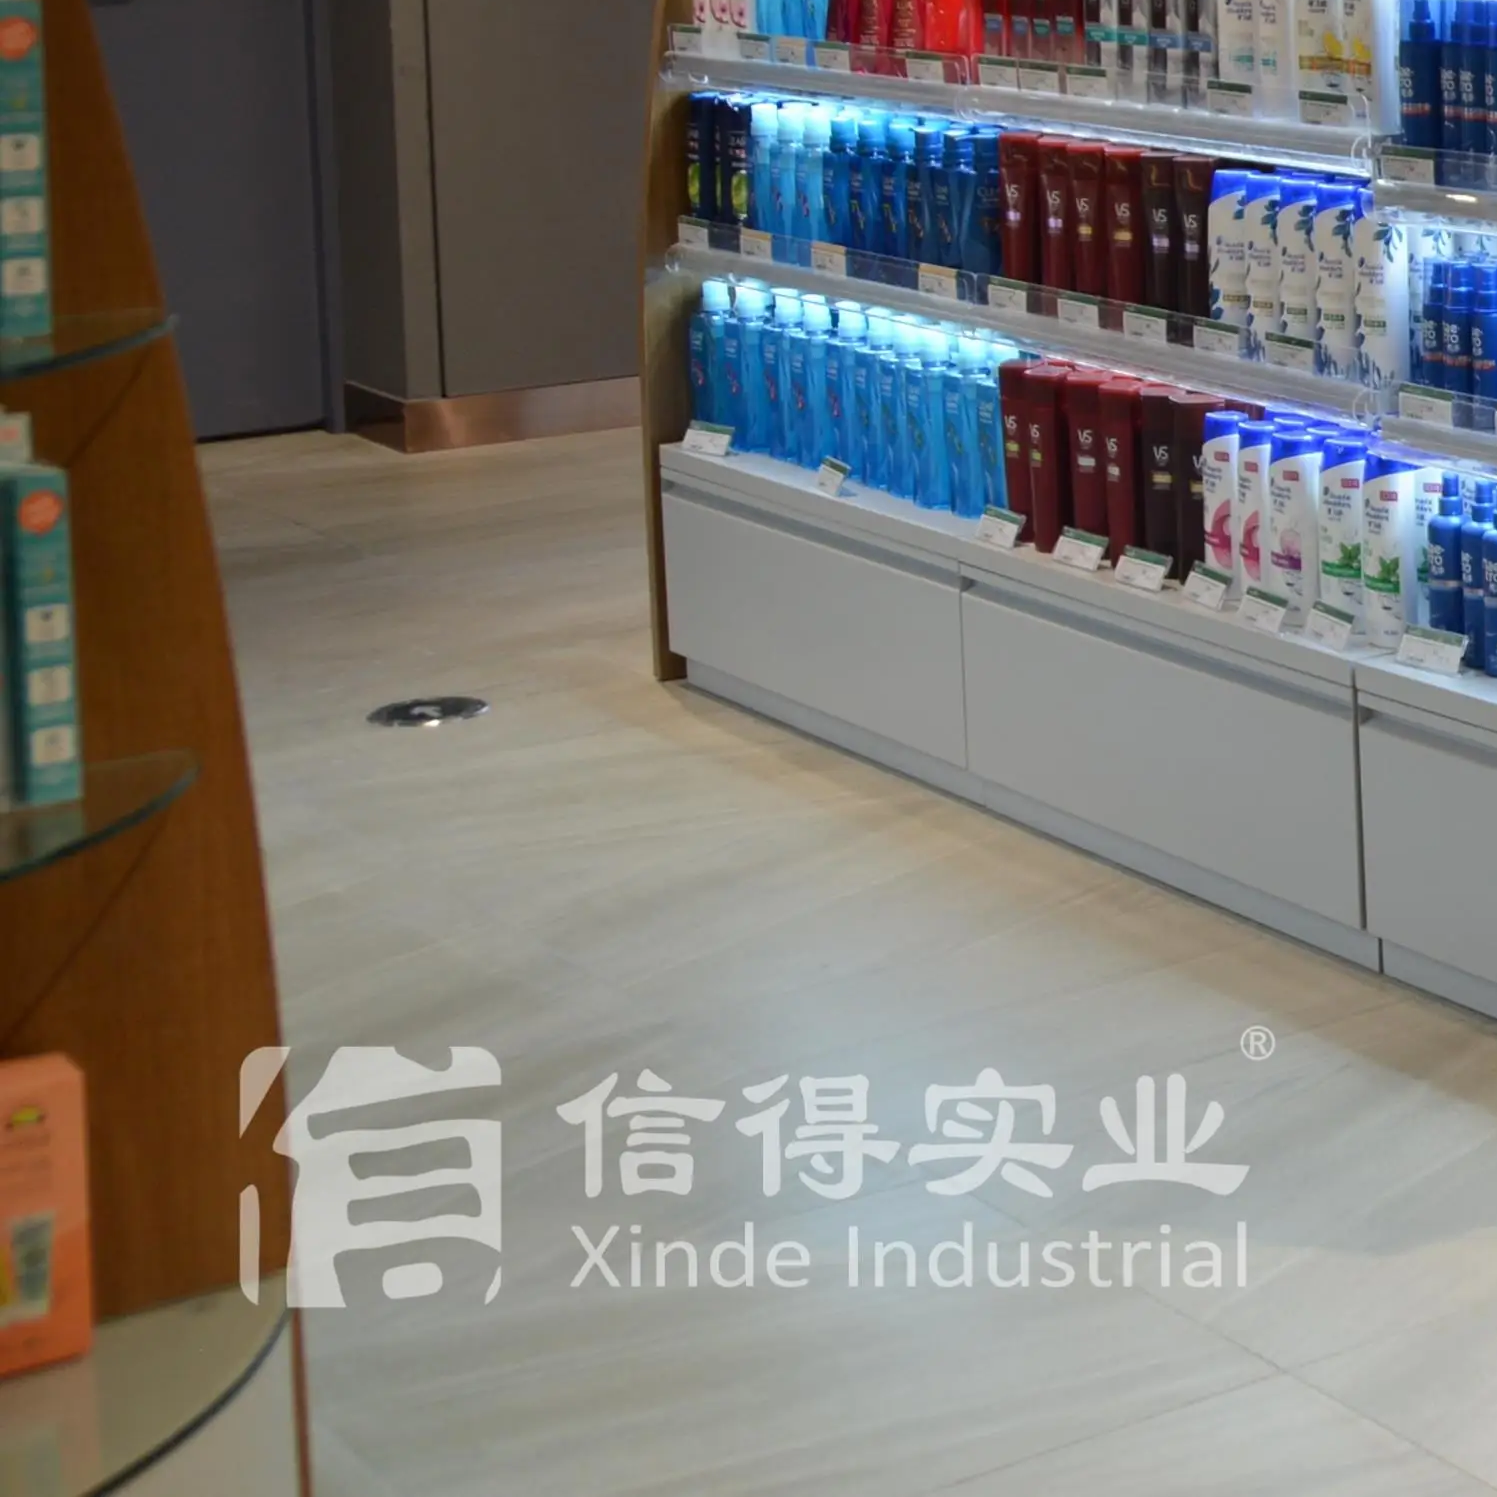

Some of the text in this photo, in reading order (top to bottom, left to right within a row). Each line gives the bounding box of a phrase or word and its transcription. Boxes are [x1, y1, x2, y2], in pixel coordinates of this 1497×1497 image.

[1114, 203, 1131, 217] VS
[1152, 208, 1168, 223] VS
[1077, 429, 1093, 444] VS
[1153, 446, 1168, 460] VS
